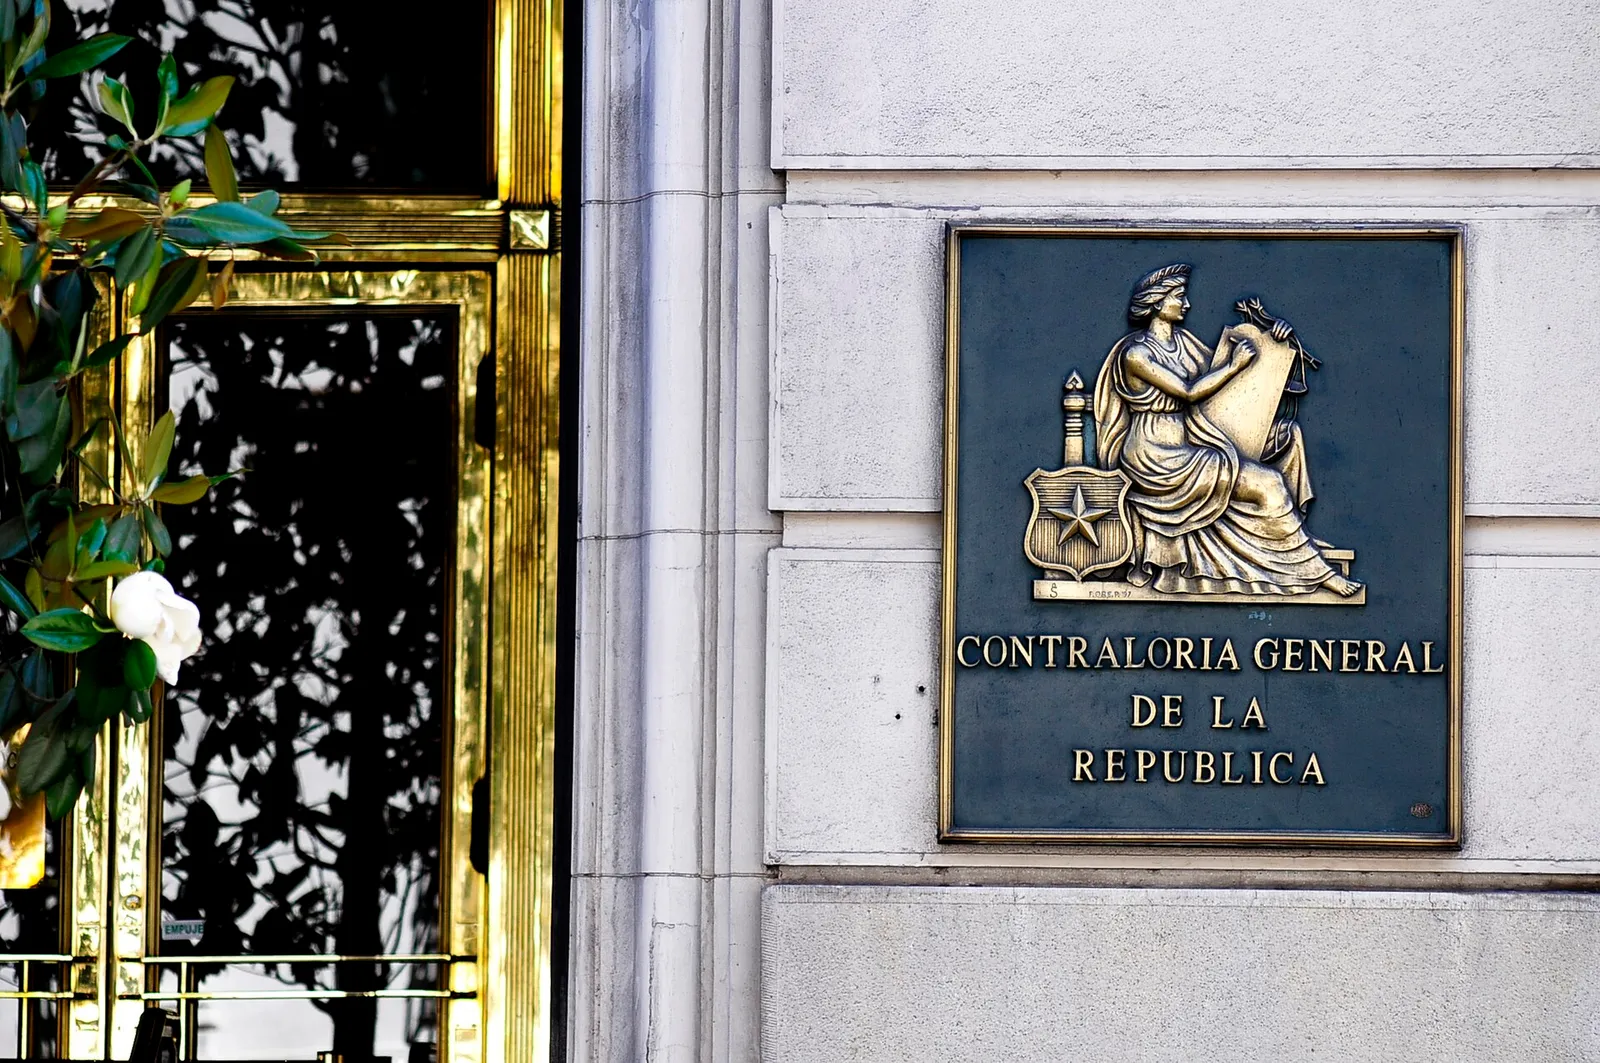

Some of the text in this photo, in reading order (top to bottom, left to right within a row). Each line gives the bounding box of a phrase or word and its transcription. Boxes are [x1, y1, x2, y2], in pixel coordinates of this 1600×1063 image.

[956, 635, 1444, 673] CONTRALORIA GENERAL
[1131, 694, 1266, 729] DE LA
[1073, 748, 1326, 785] REPUBLICA
[164, 924, 204, 935] EMPUJE
